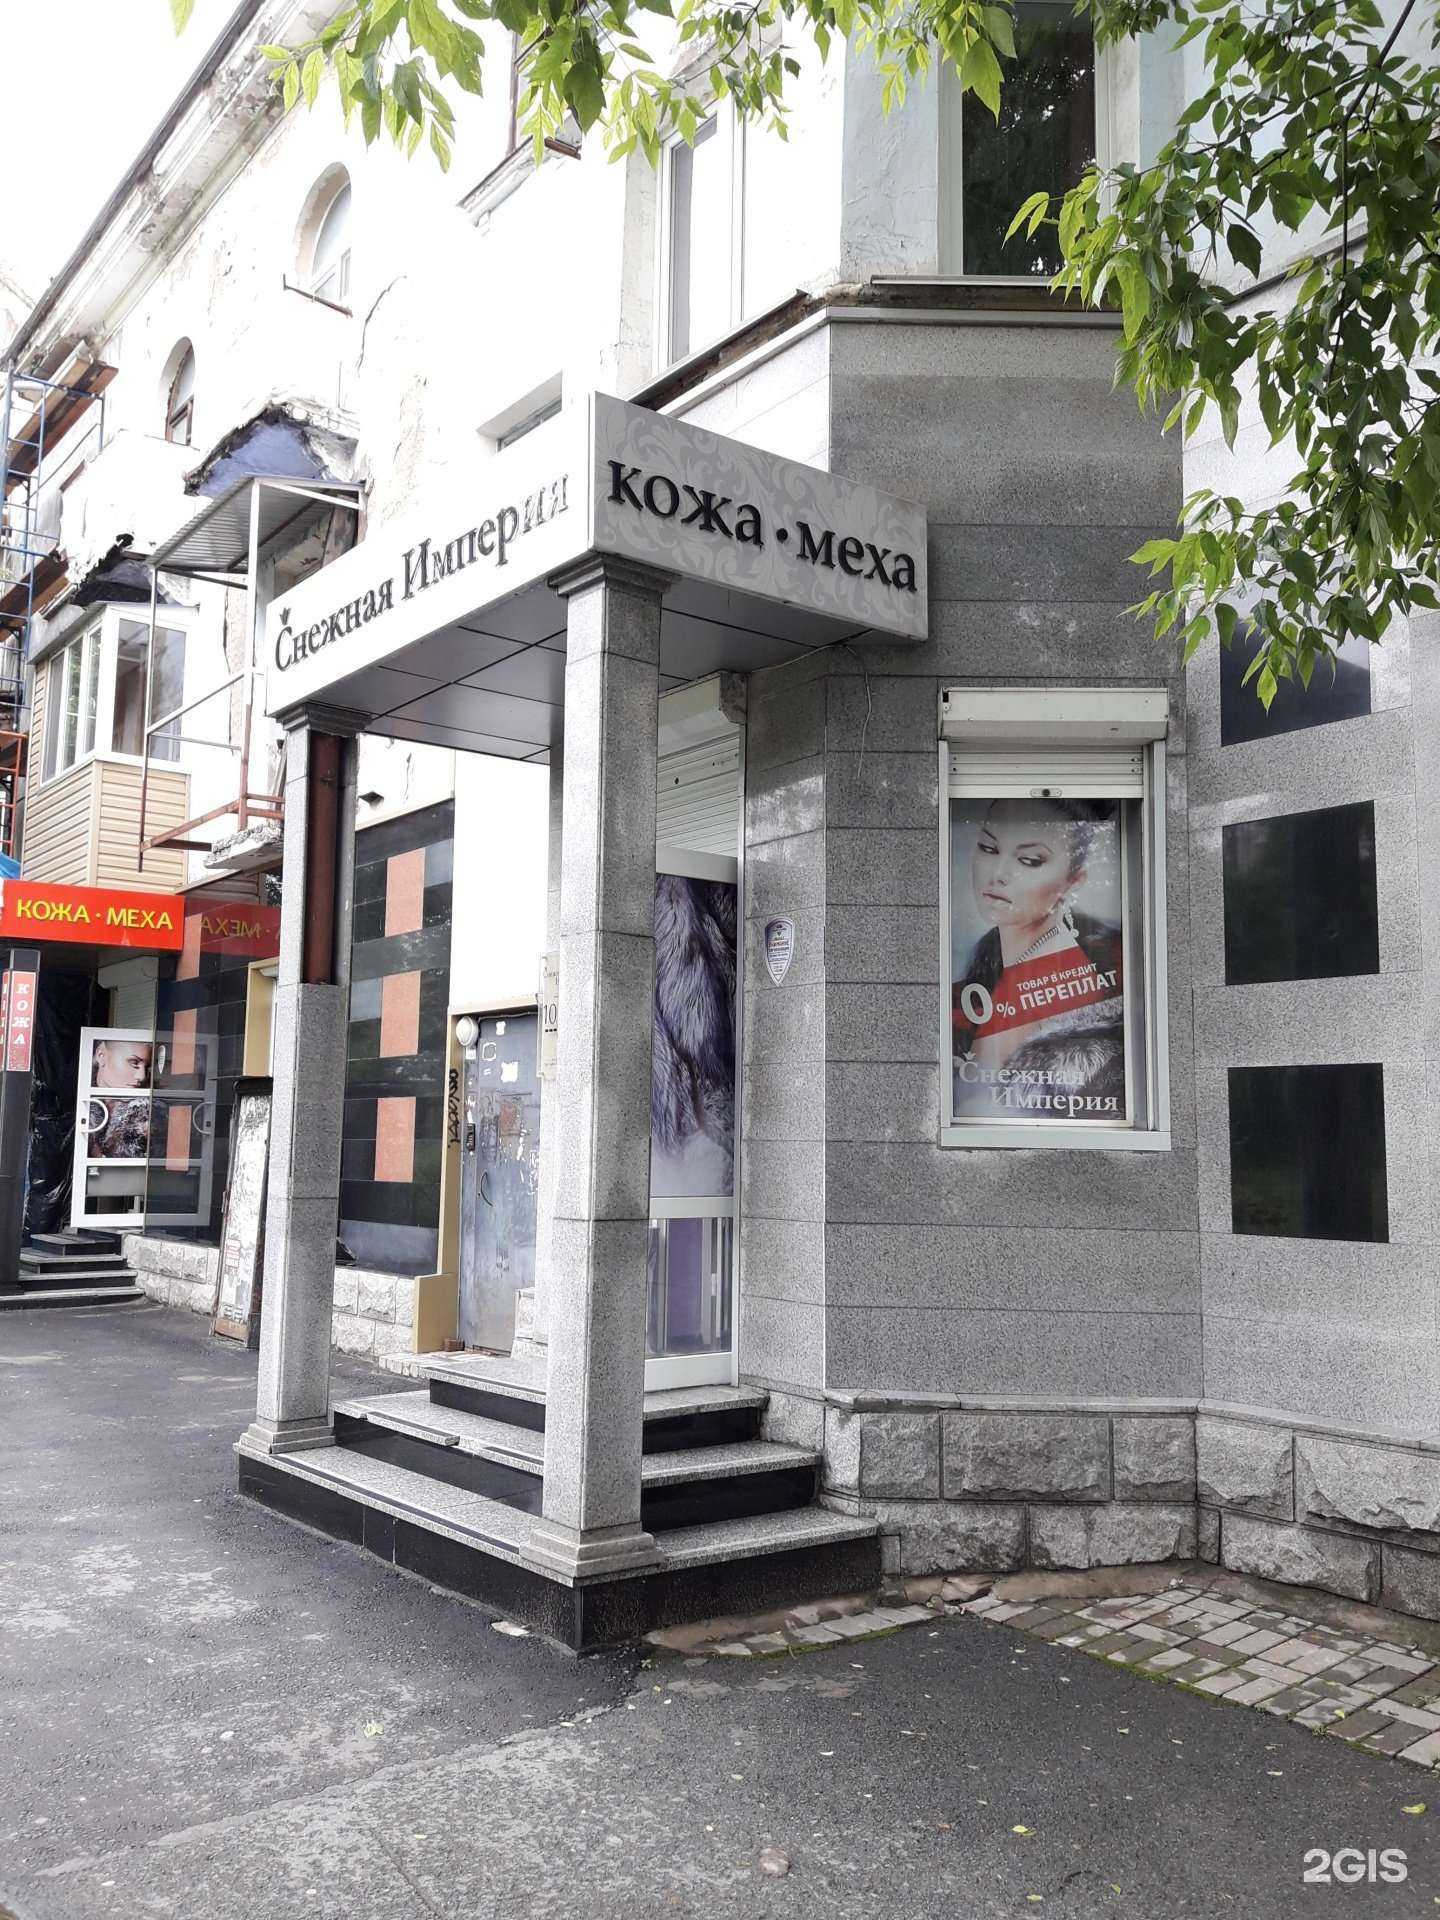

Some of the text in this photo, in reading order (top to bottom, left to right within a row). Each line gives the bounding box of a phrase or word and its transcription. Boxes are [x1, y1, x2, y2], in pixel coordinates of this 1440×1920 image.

[274, 473, 569, 672] Снежная Империя
[16, 898, 174, 931] КОЖА МЕХА
[1016, 962, 1098, 992] ТОВАР В КРЕДИТ
[1019, 970, 1118, 1011] ПЕРЕПЛАТ
[12, 983, 31, 1045] КОЖА
[958, 1061, 1086, 1085] Снежная
[989, 1085, 1120, 1117] Империя
